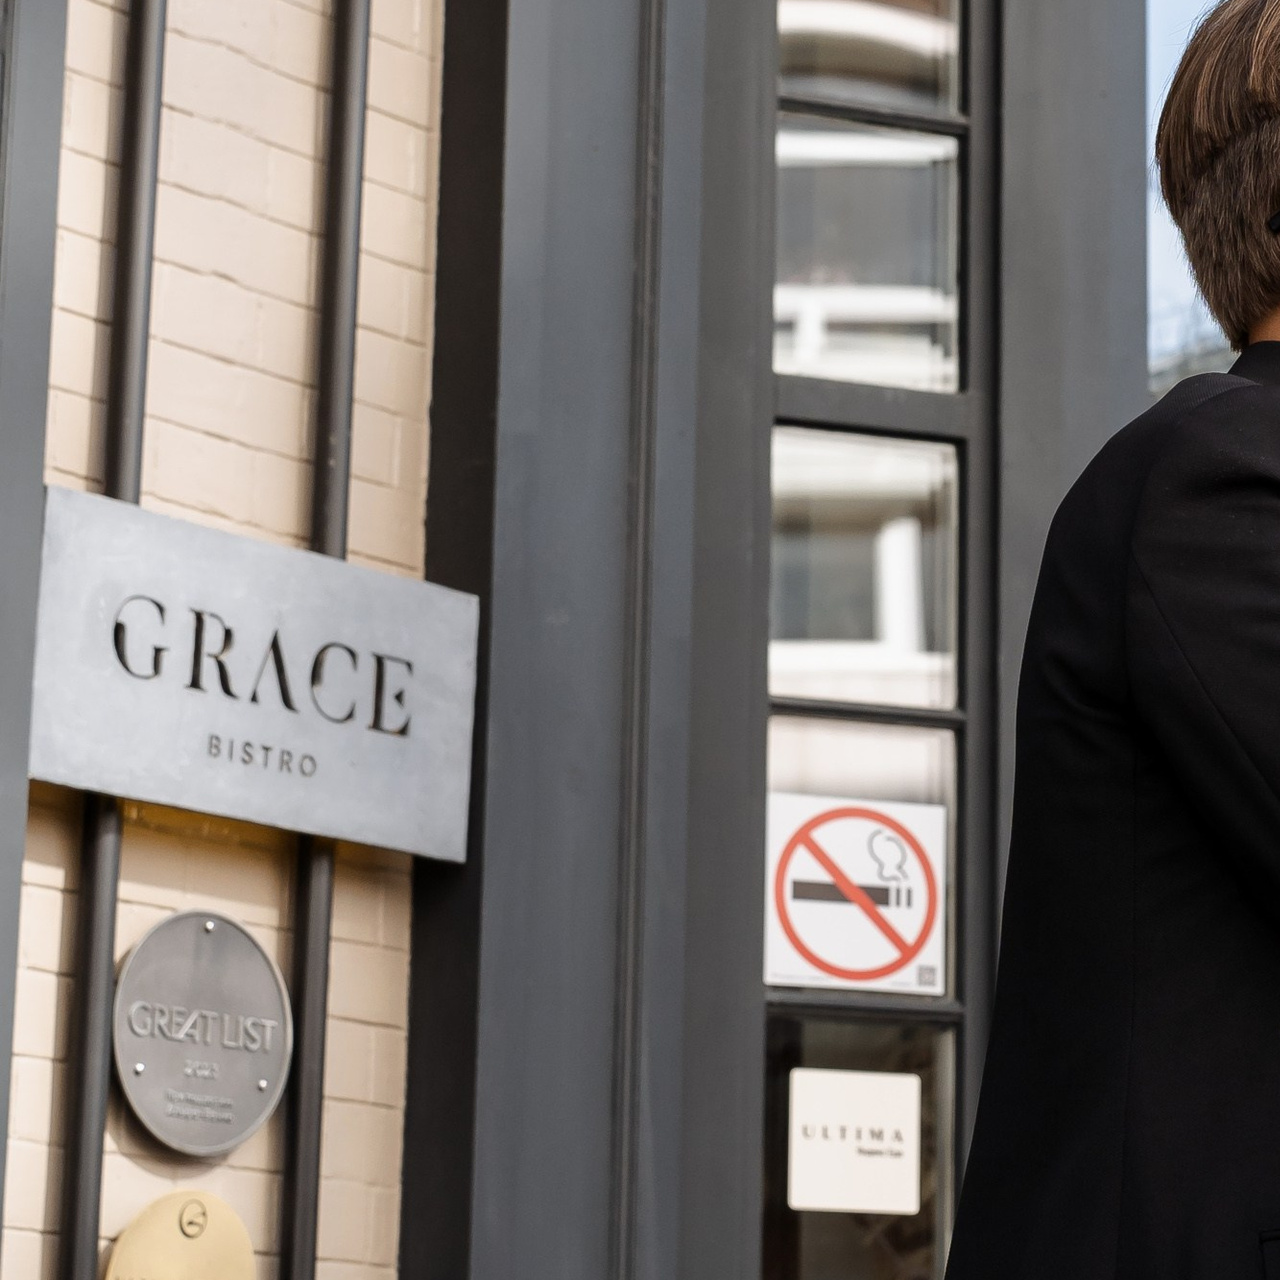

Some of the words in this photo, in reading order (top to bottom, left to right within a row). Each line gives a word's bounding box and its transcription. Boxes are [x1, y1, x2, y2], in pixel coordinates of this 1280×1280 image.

[113, 594, 413, 737] GRACE
[207, 734, 318, 777] BISTRO
[128, 1000, 218, 1046] GREAT
[222, 1013, 279, 1052] LIST
[802, 1124, 904, 1144] ULTIMA
